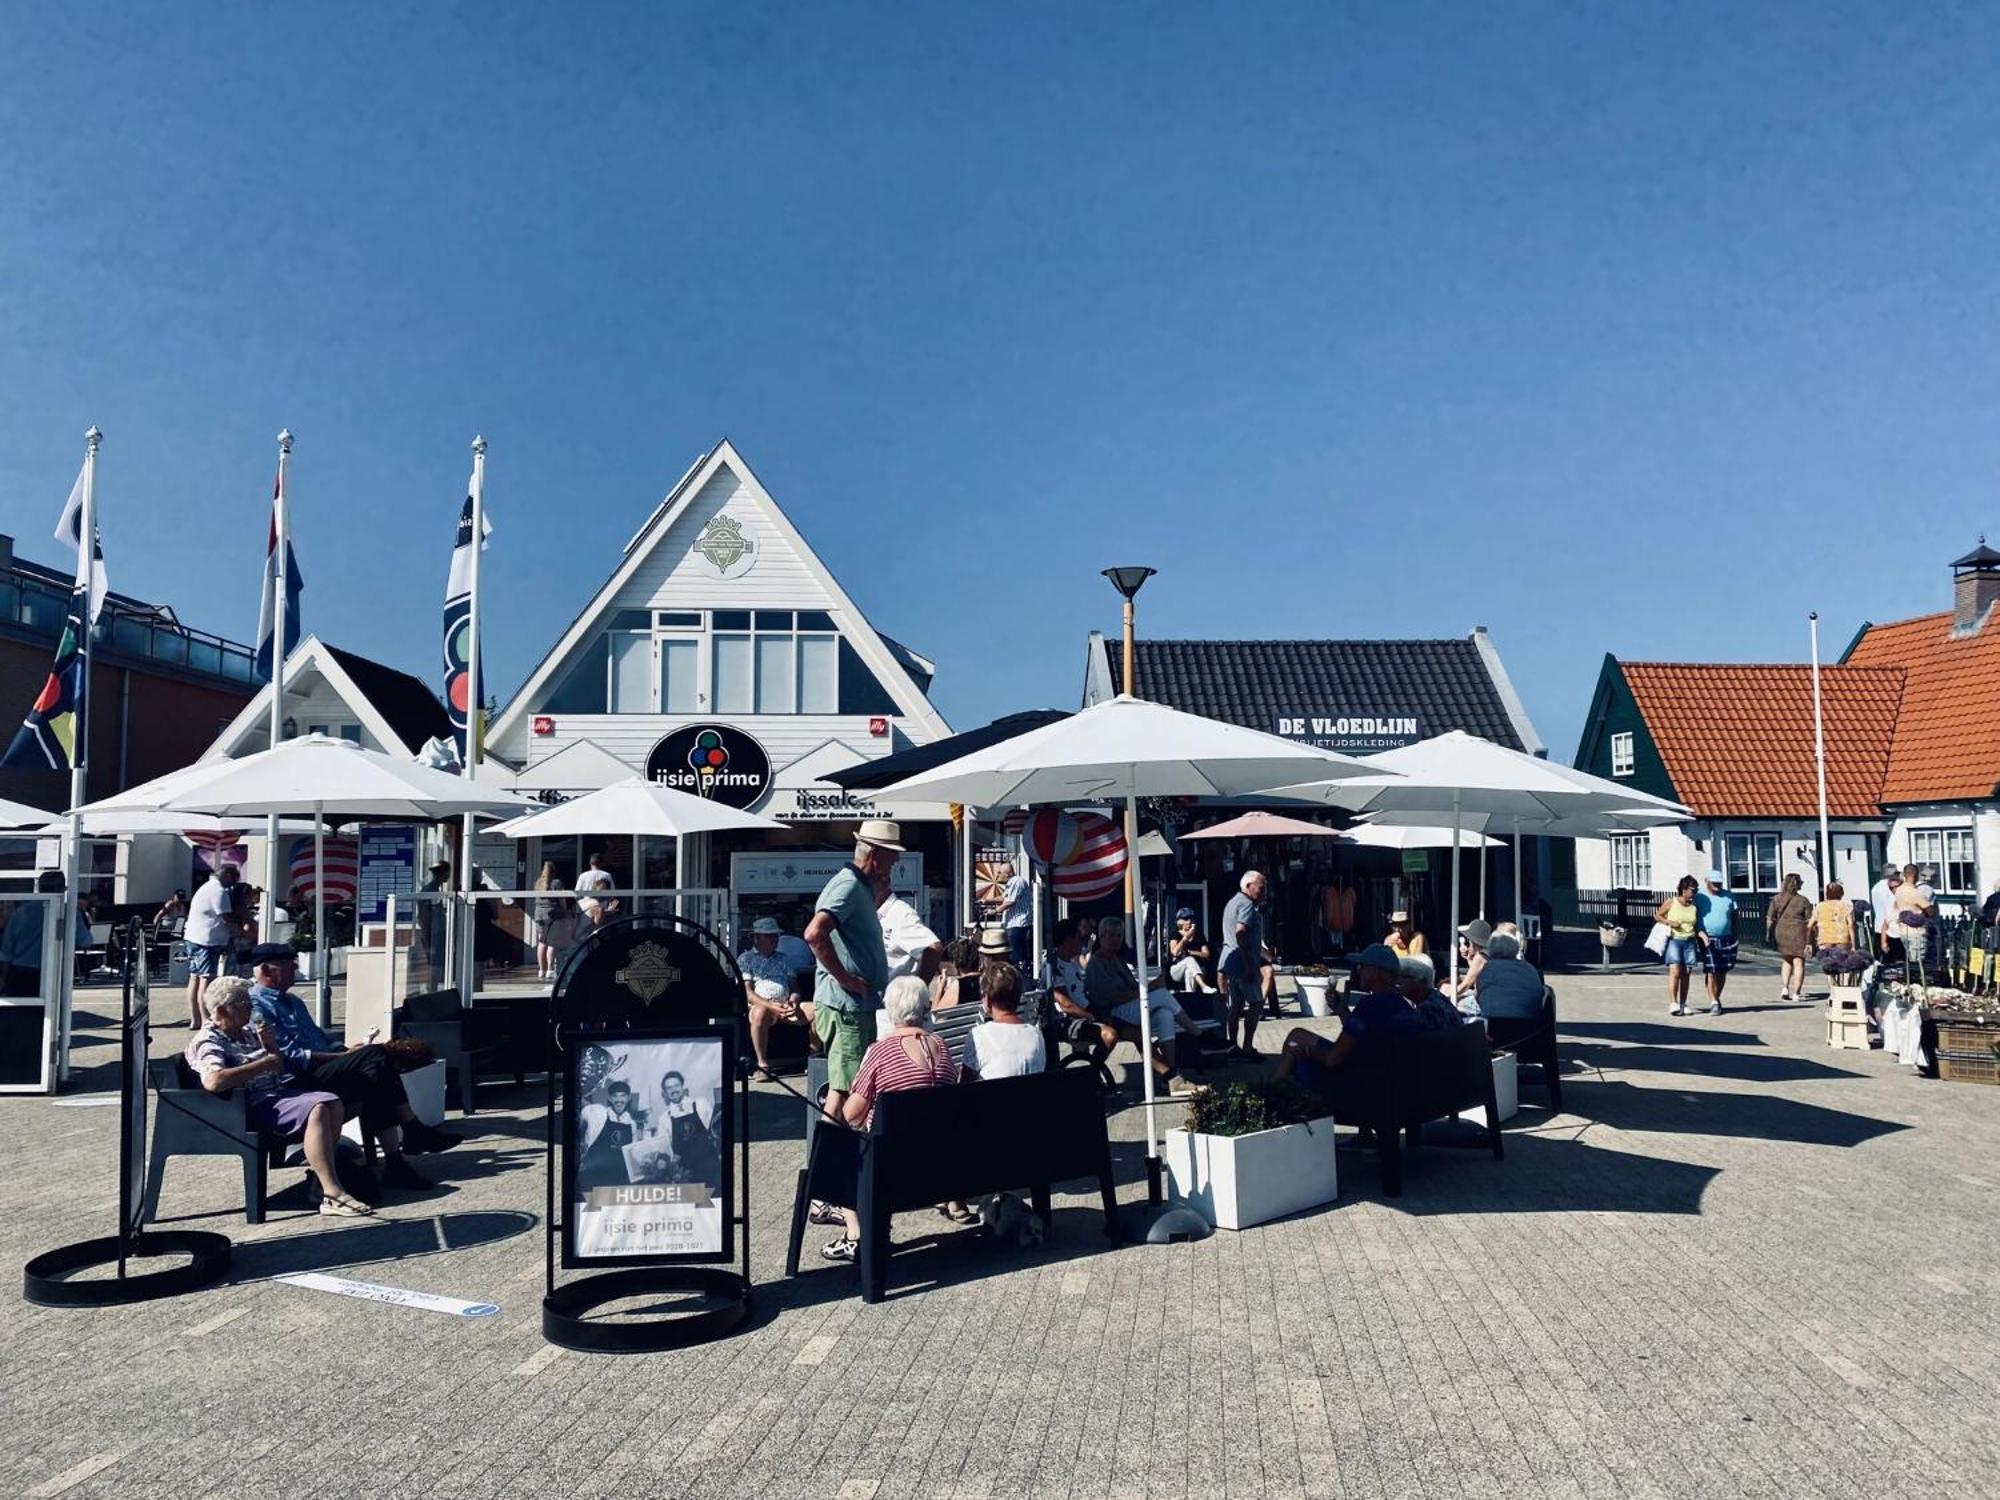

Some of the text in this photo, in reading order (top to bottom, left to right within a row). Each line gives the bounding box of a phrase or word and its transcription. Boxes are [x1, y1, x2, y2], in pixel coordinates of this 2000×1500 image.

[1278, 718, 1417, 735] DE VLOEDLIJN
[656, 768, 760, 790] ijsie prima
[615, 1186, 682, 1203] HULDE!
[604, 1218, 694, 1236] ijsie prima
